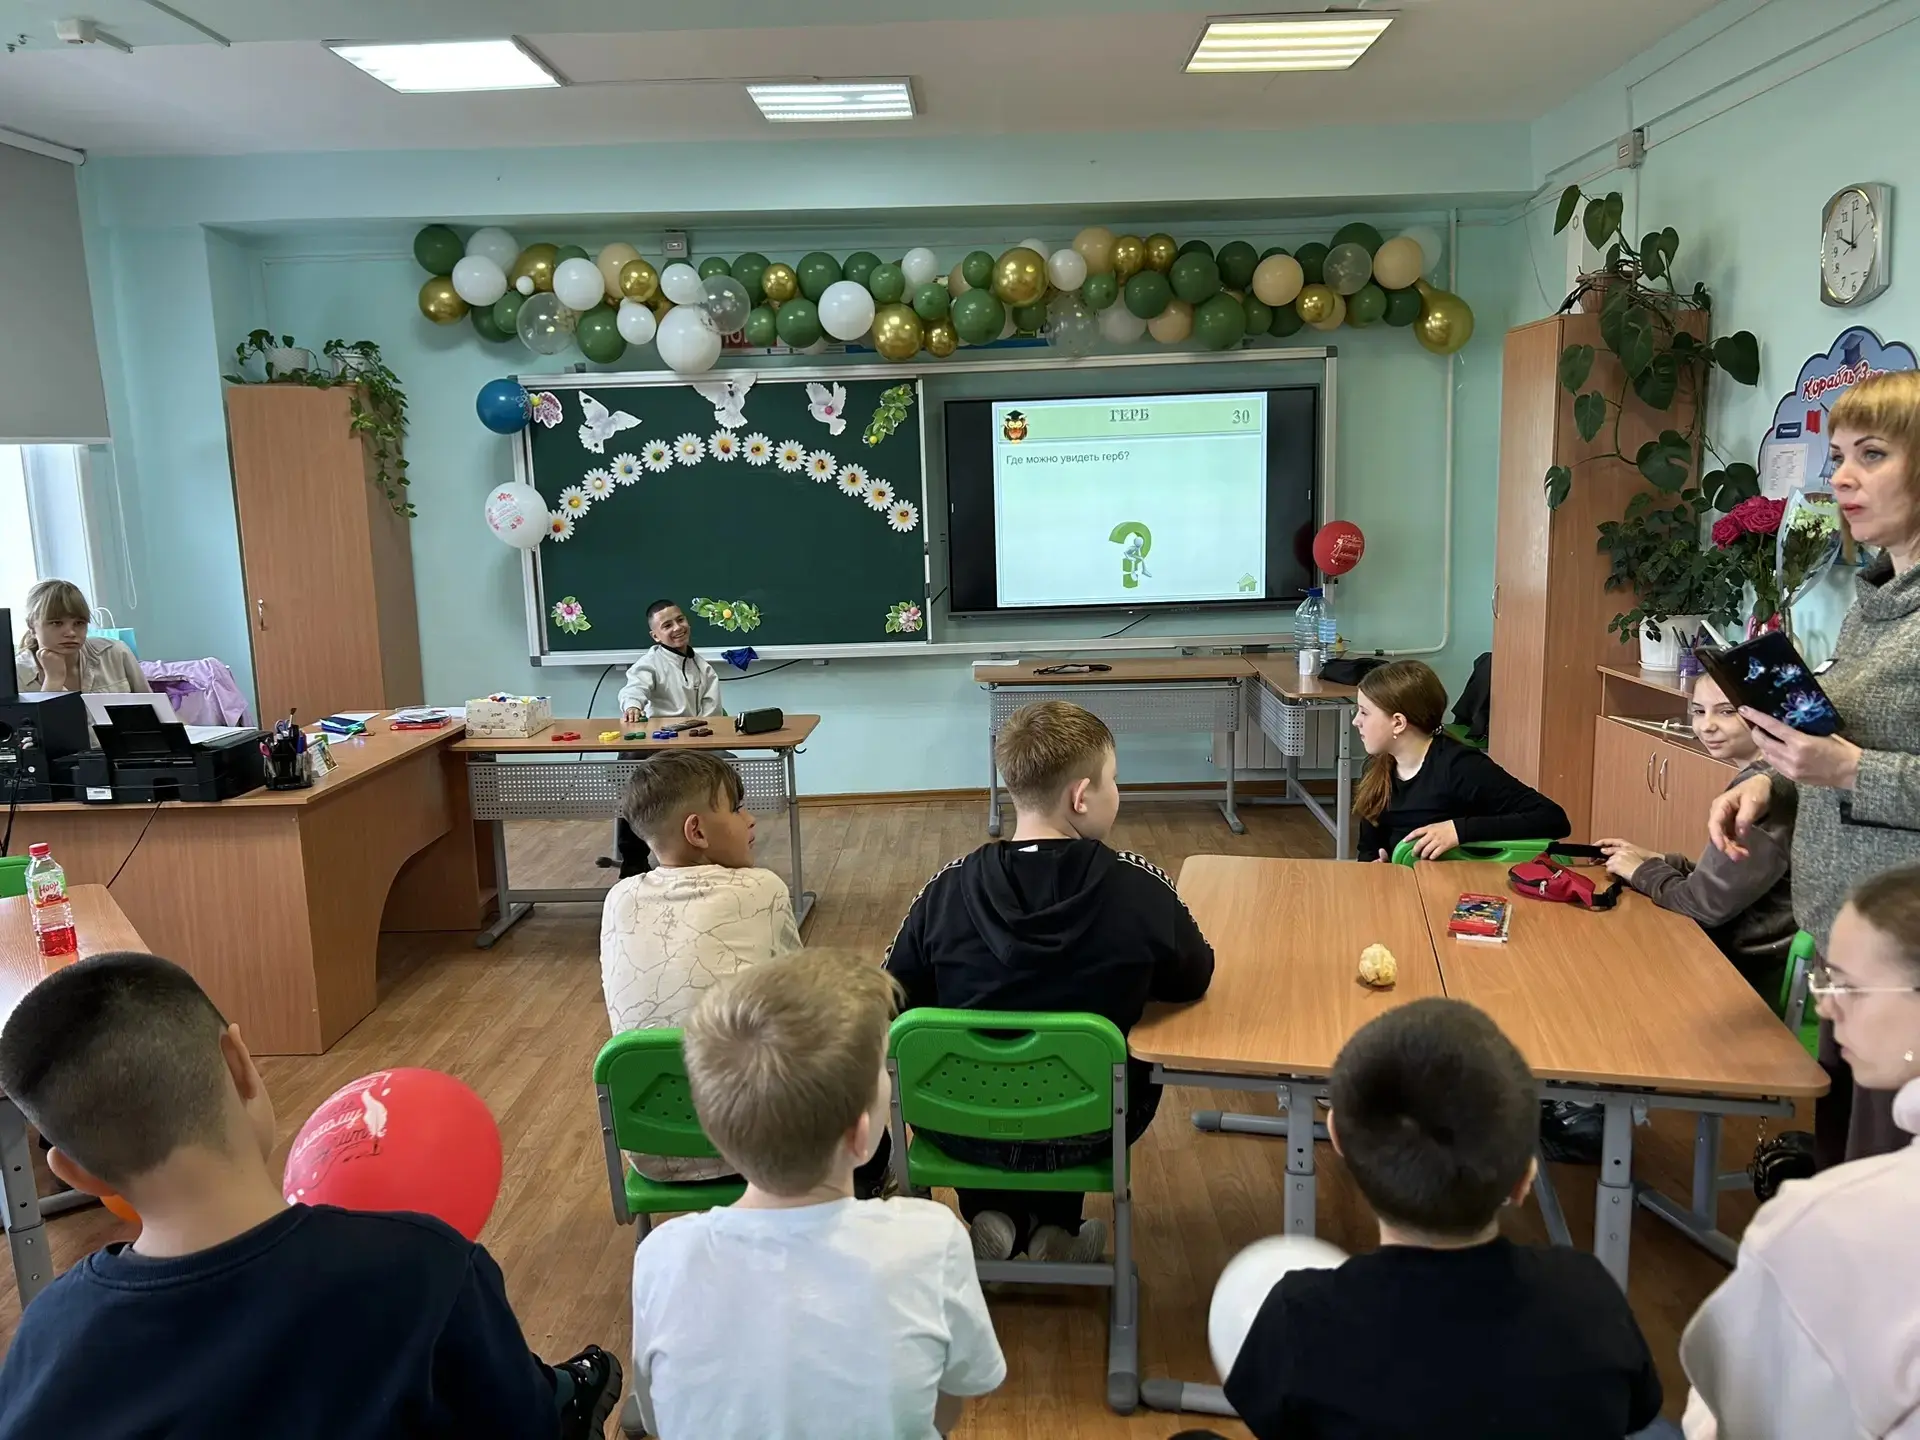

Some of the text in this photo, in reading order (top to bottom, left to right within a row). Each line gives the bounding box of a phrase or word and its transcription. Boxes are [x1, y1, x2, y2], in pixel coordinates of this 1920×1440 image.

[1109, 408, 1250, 424] ГЕРБ 30
[1006, 451, 1130, 465] Где можно увидеть герб?
